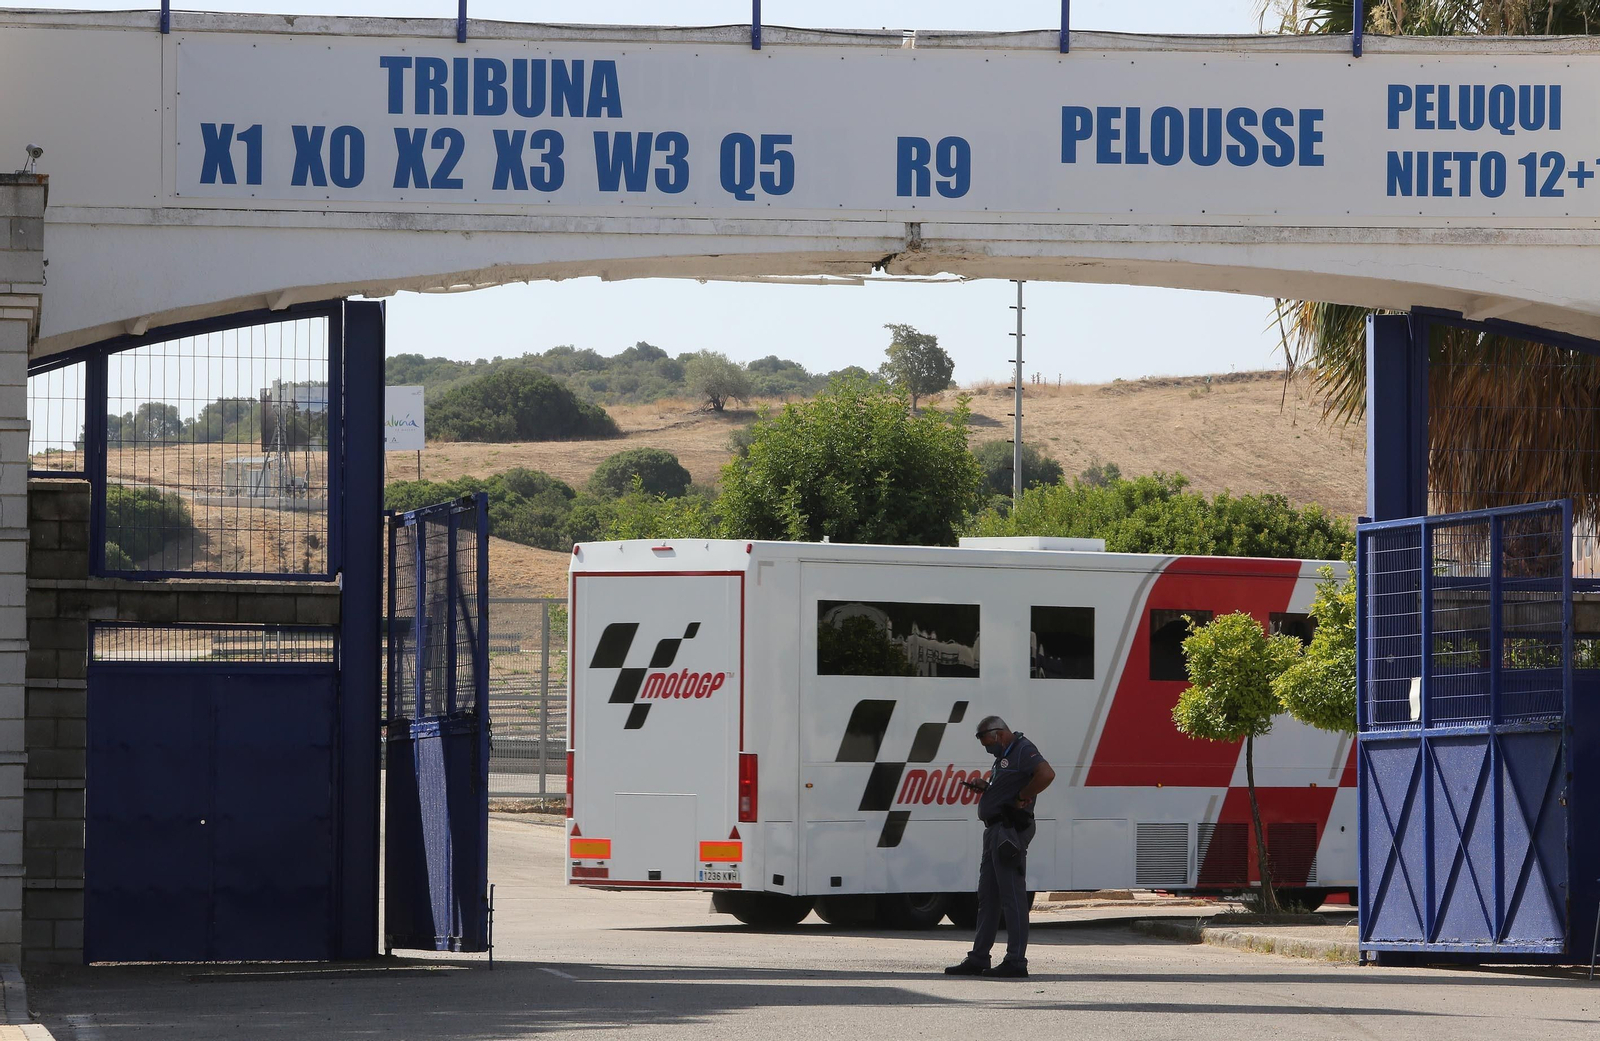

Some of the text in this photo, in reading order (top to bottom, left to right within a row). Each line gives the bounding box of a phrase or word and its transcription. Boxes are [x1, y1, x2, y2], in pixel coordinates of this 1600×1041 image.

[380, 56, 623, 118] TRIBUNA
[1387, 84, 1561, 135] PELUQUI
[200, 123, 971, 201] X1 X0 X2 X3 W3 Q5 R9
[1061, 106, 1324, 167] PELOUSSE
[1387, 151, 1507, 198] NIETO
[704, 872, 721, 881] 1236
